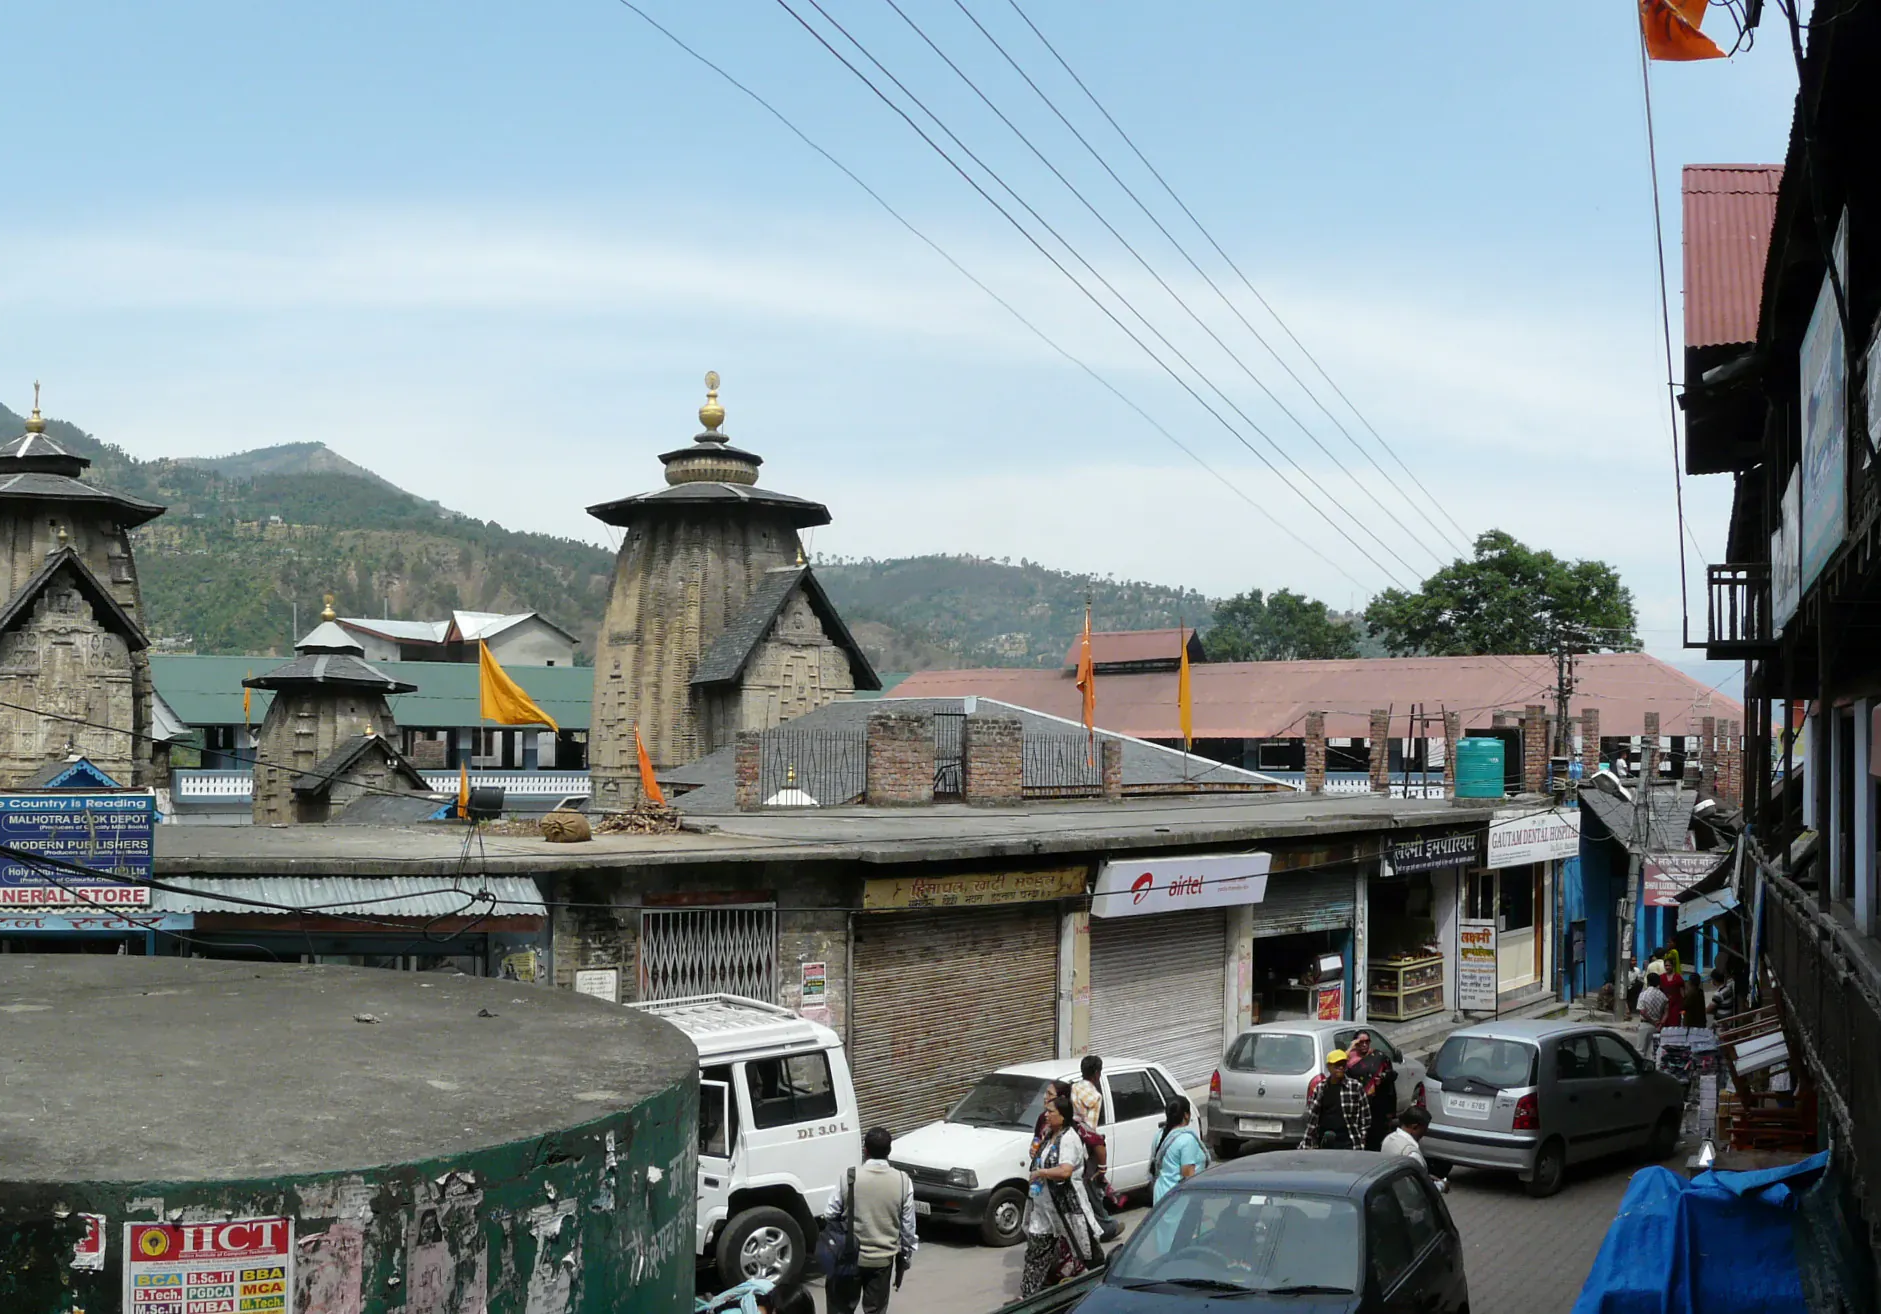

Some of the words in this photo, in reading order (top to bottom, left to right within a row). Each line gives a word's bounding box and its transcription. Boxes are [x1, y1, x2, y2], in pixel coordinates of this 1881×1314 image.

[9, 799, 67, 810] Country
[86, 799, 146, 810] Reading
[9, 815, 70, 824] MALHOTRA
[110, 815, 148, 824] DEPOT
[1492, 830, 1522, 848] GAUTAM
[1523, 827, 1548, 844] DENTAL
[1550, 823, 1578, 842] HOSPITAL
[10, 841, 64, 850] MODERN
[8, 867, 28, 877] Holy
[1169, 875, 1204, 896] airtel
[78, 889, 145, 903] STORE
[797, 1128, 814, 1139] DI
[818, 1124, 836, 1136] 3.0
[840, 1122, 849, 1131] L
[180, 1221, 282, 1253] IICT
[136, 1275, 181, 1286] BCA
[189, 1273, 218, 1284] B.Sc.
[221, 1272, 232, 1282] IT
[243, 1268, 283, 1281] BBA
[136, 1290, 181, 1301] B.Tech.
[189, 1287, 232, 1299] PGDCA
[243, 1282, 282, 1295] MCA
[136, 1303, 182, 1314] M.Sc.IT
[190, 1302, 233, 1313] MBA
[241, 1298, 284, 1310] M.Tech.
